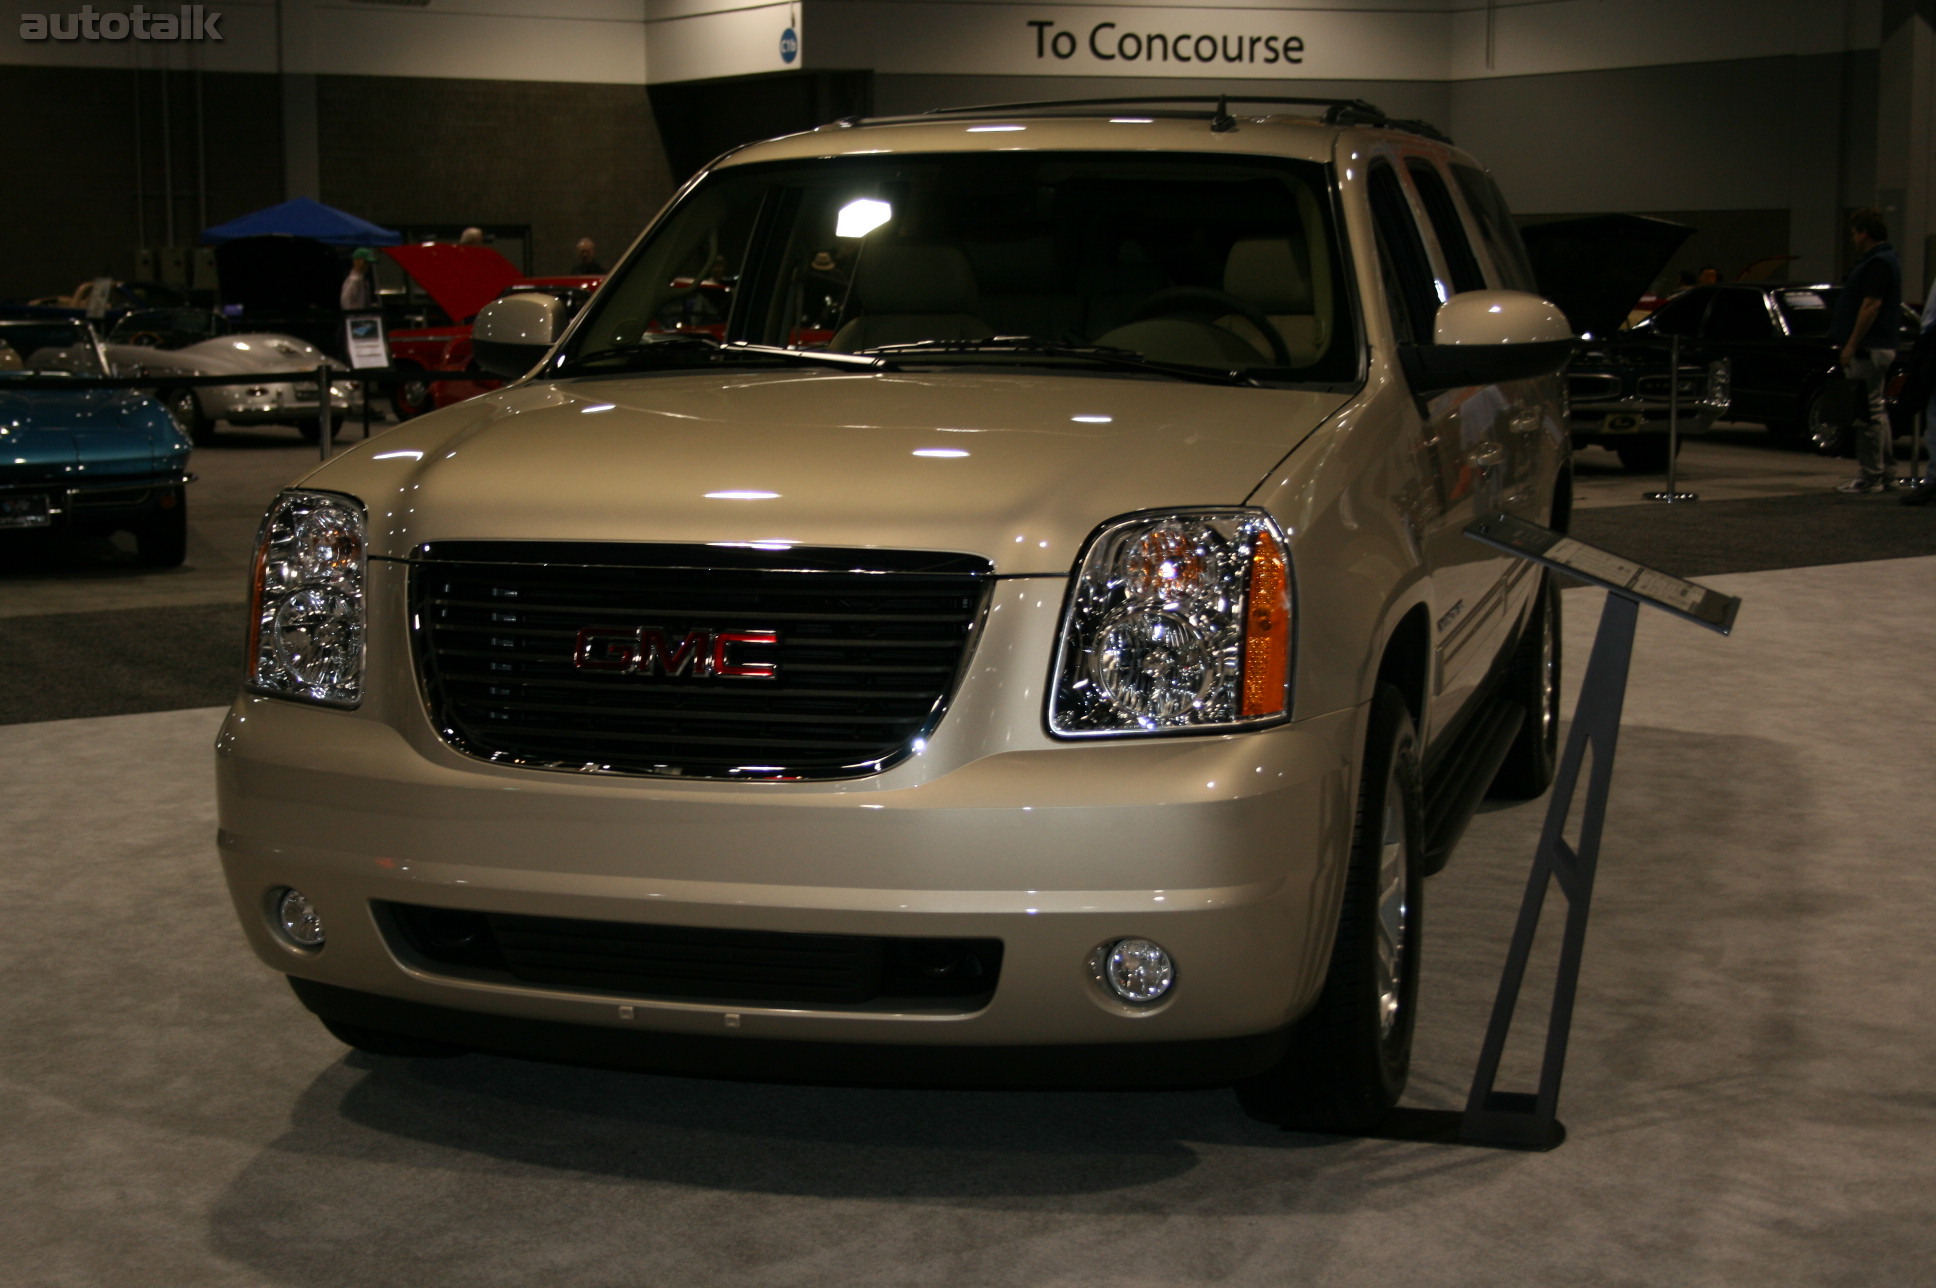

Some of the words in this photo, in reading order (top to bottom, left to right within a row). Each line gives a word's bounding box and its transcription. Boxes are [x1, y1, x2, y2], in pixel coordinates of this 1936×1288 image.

[1028, 20, 1076, 59] To
[1089, 23, 1304, 63] Concourse
[574, 626, 779, 680] GMC
